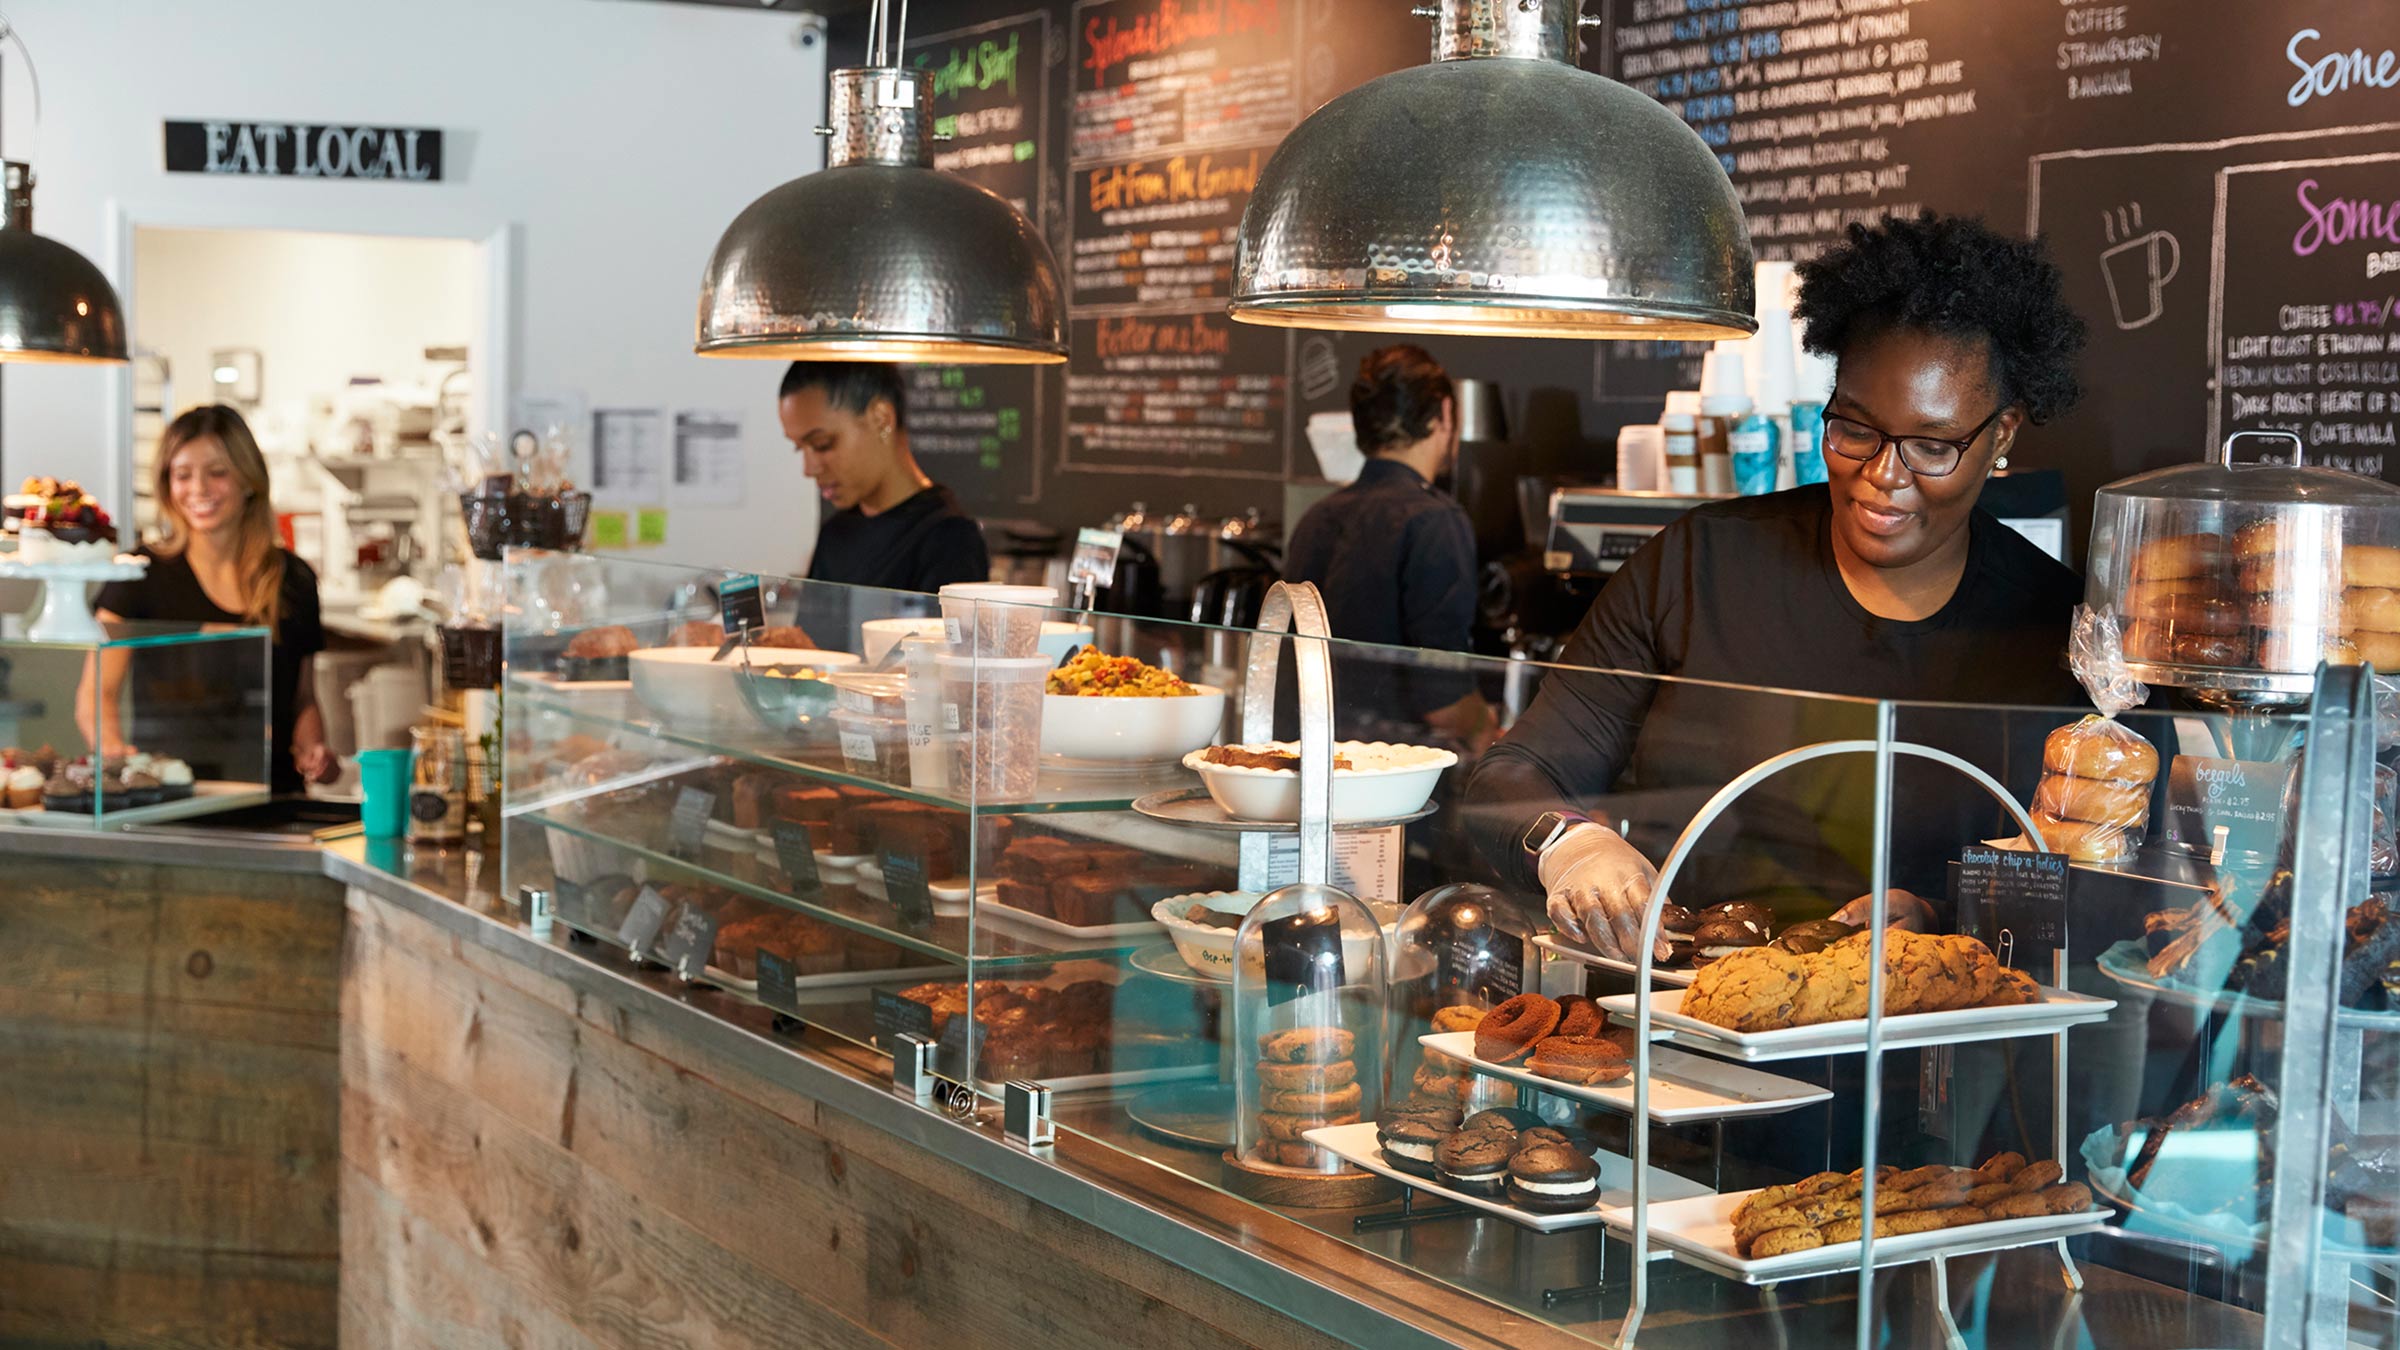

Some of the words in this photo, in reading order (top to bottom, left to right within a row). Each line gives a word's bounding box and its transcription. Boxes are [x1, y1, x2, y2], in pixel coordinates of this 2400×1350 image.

[2065, 5, 2128, 35] COFFEE
[1872, 44, 1889, 68] &
[1891, 38, 1929, 66] DATES
[2057, 33, 2162, 70] STRAWBERRY
[1930, 59, 1964, 85] JUICE
[2286, 28, 2400, 107] Some
[2068, 69, 2133, 99] BANANA
[202, 122, 288, 174] EAT
[293, 126, 432, 180] LOCAL
[2279, 304, 2331, 331] COFFEE
[2228, 336, 2270, 360] LIGHT
[2316, 363, 2355, 385] COSTA
[2232, 392, 2270, 421] DARK
[2320, 391, 2365, 415] HEART
[2367, 390, 2387, 414] OF
[2309, 421, 2396, 446] GUATEMALA
[2255, 811, 2275, 823] $2.95
[1962, 849, 1999, 870] chocolate
